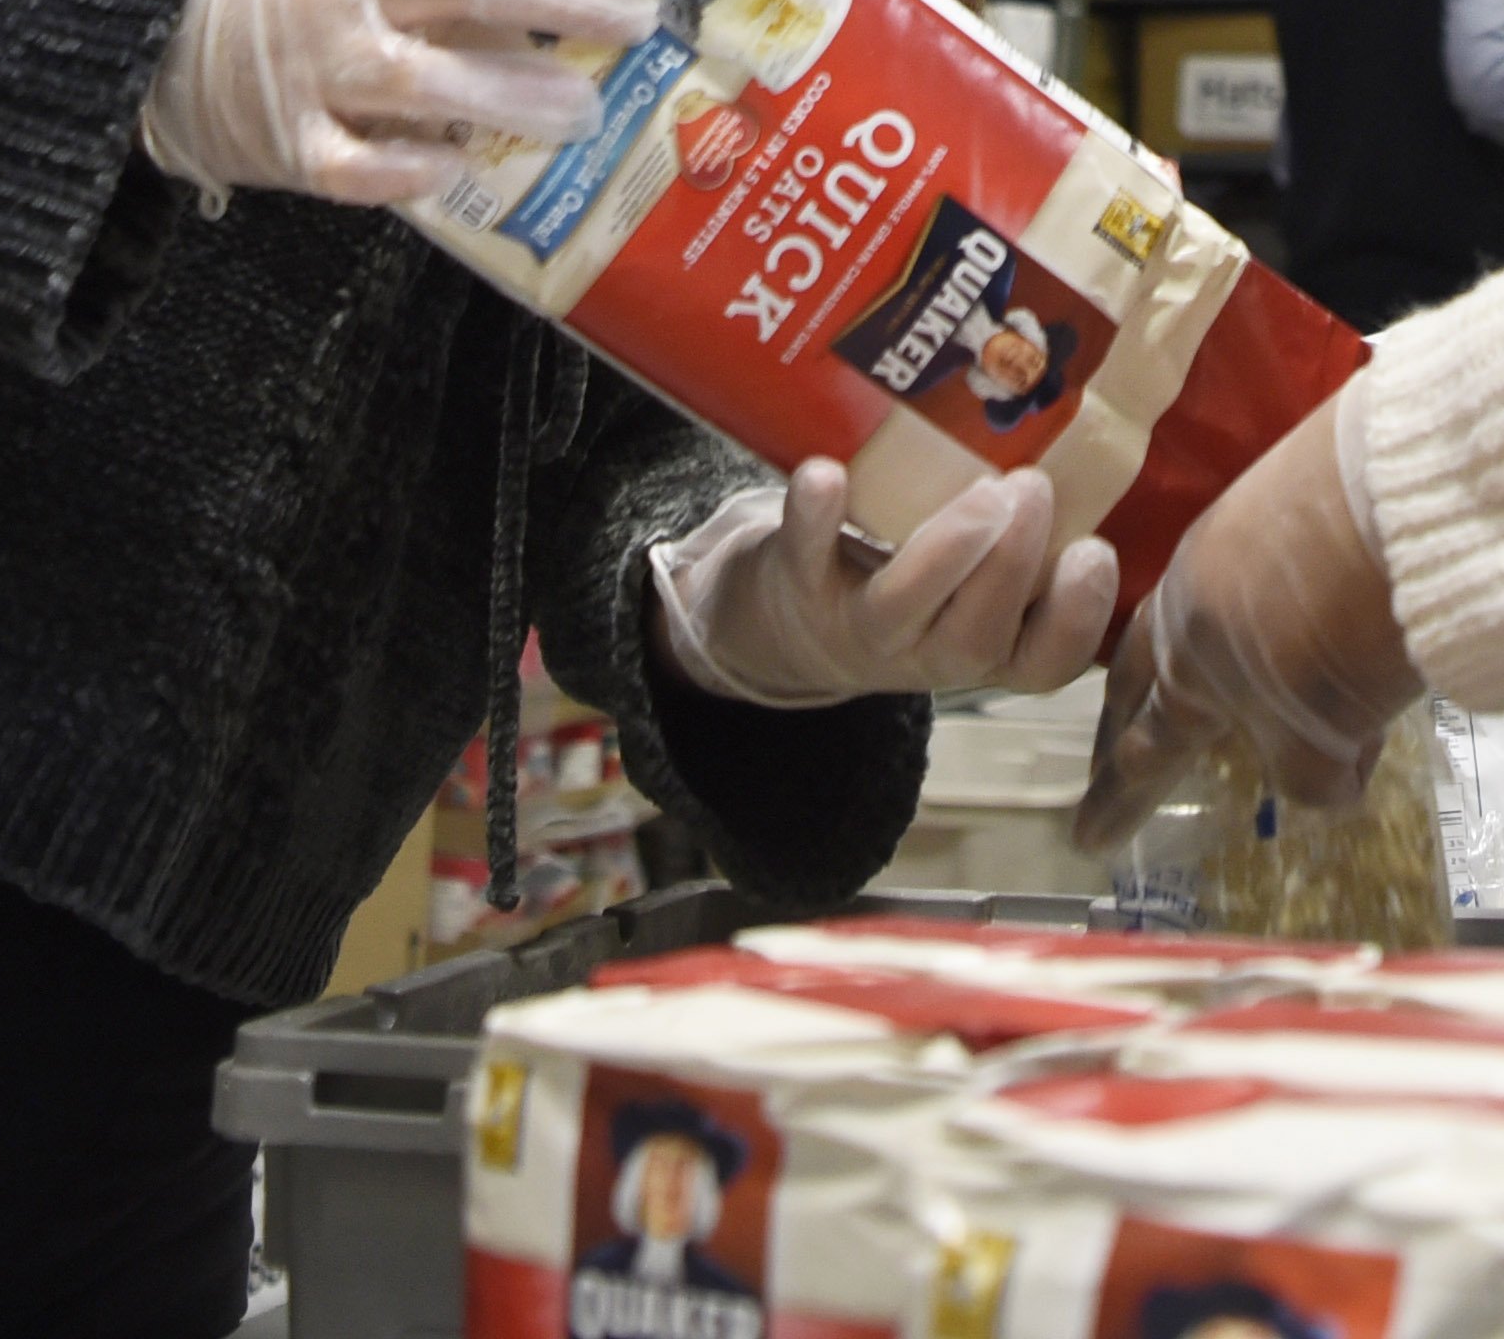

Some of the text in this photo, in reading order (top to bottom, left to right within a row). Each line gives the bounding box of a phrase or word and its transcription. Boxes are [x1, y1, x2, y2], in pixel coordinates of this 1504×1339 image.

[722, 107, 917, 345] QUICK
[742, 143, 826, 244] OATS
[870, 227, 1009, 393] QUAKER
